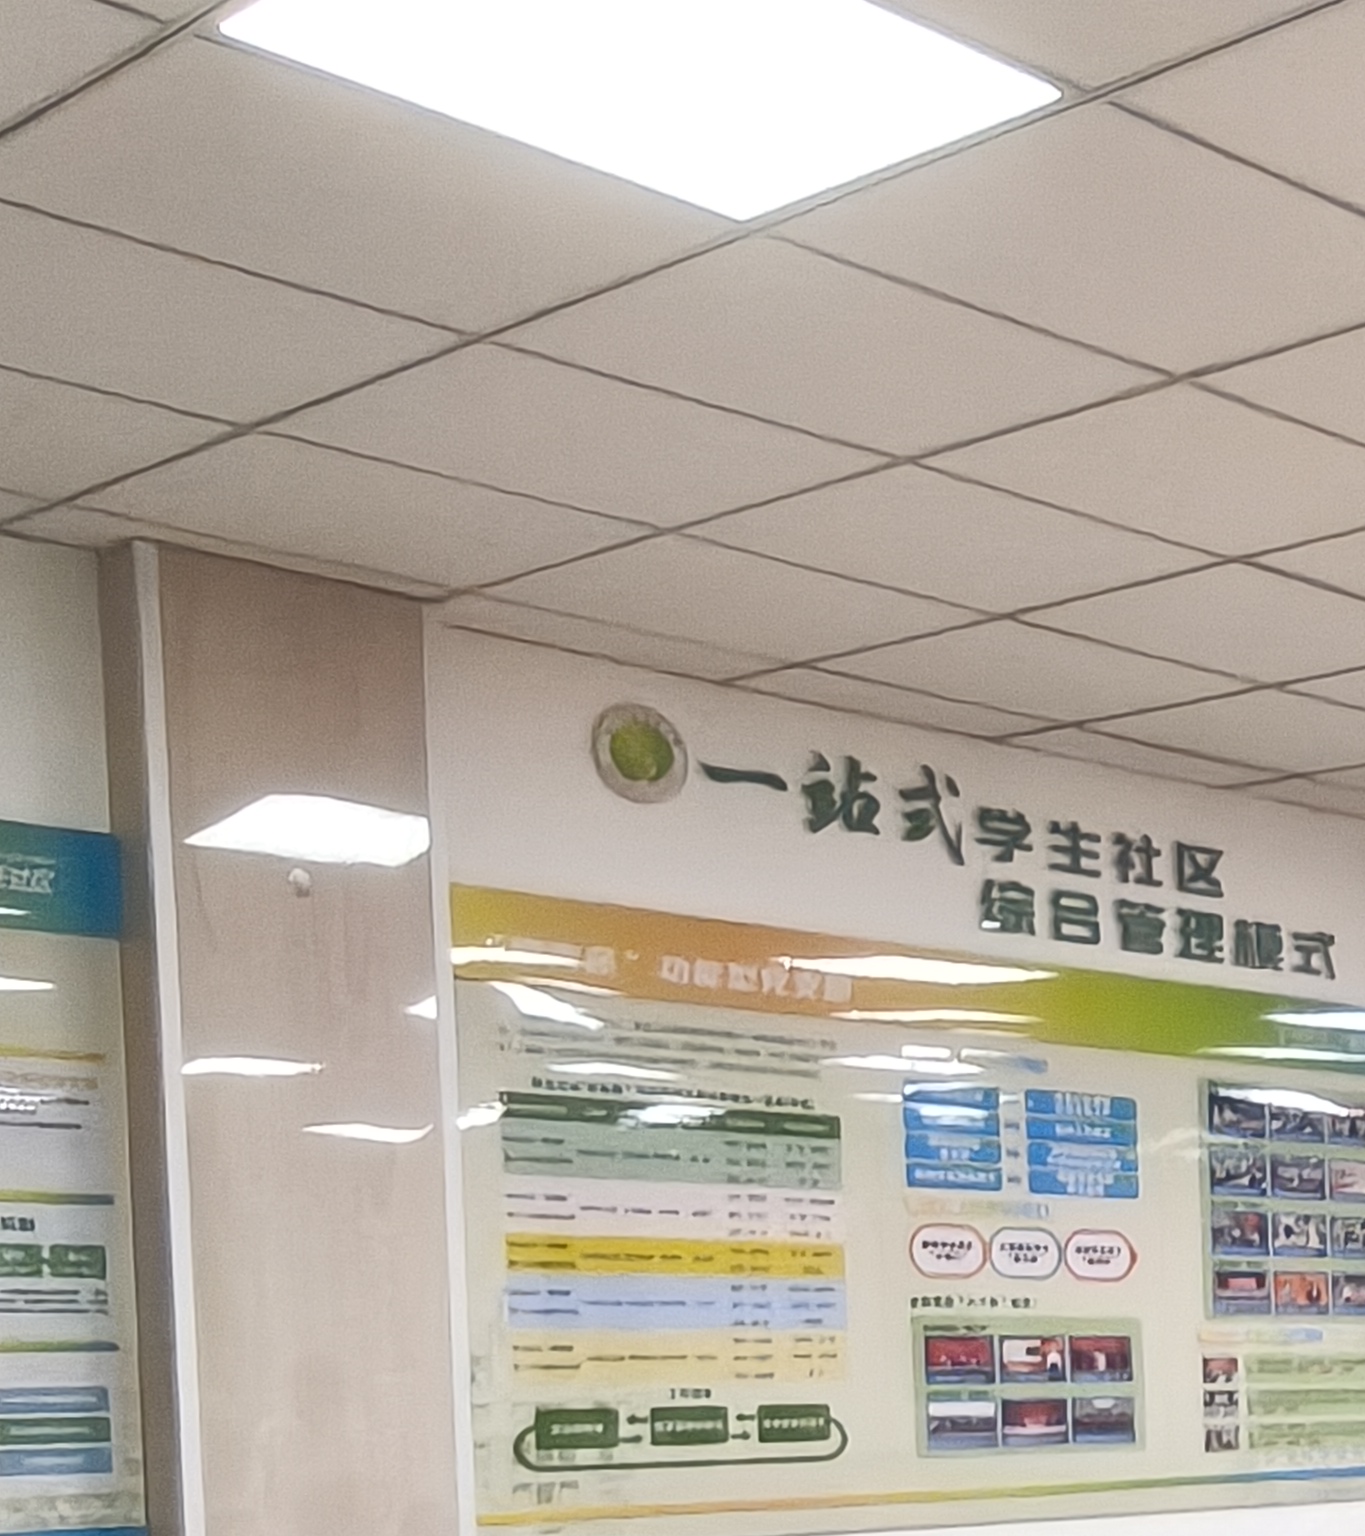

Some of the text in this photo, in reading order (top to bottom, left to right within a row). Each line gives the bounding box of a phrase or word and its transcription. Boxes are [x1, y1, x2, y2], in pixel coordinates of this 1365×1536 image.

[697, 750, 1225, 898] 一站式 学生社区
